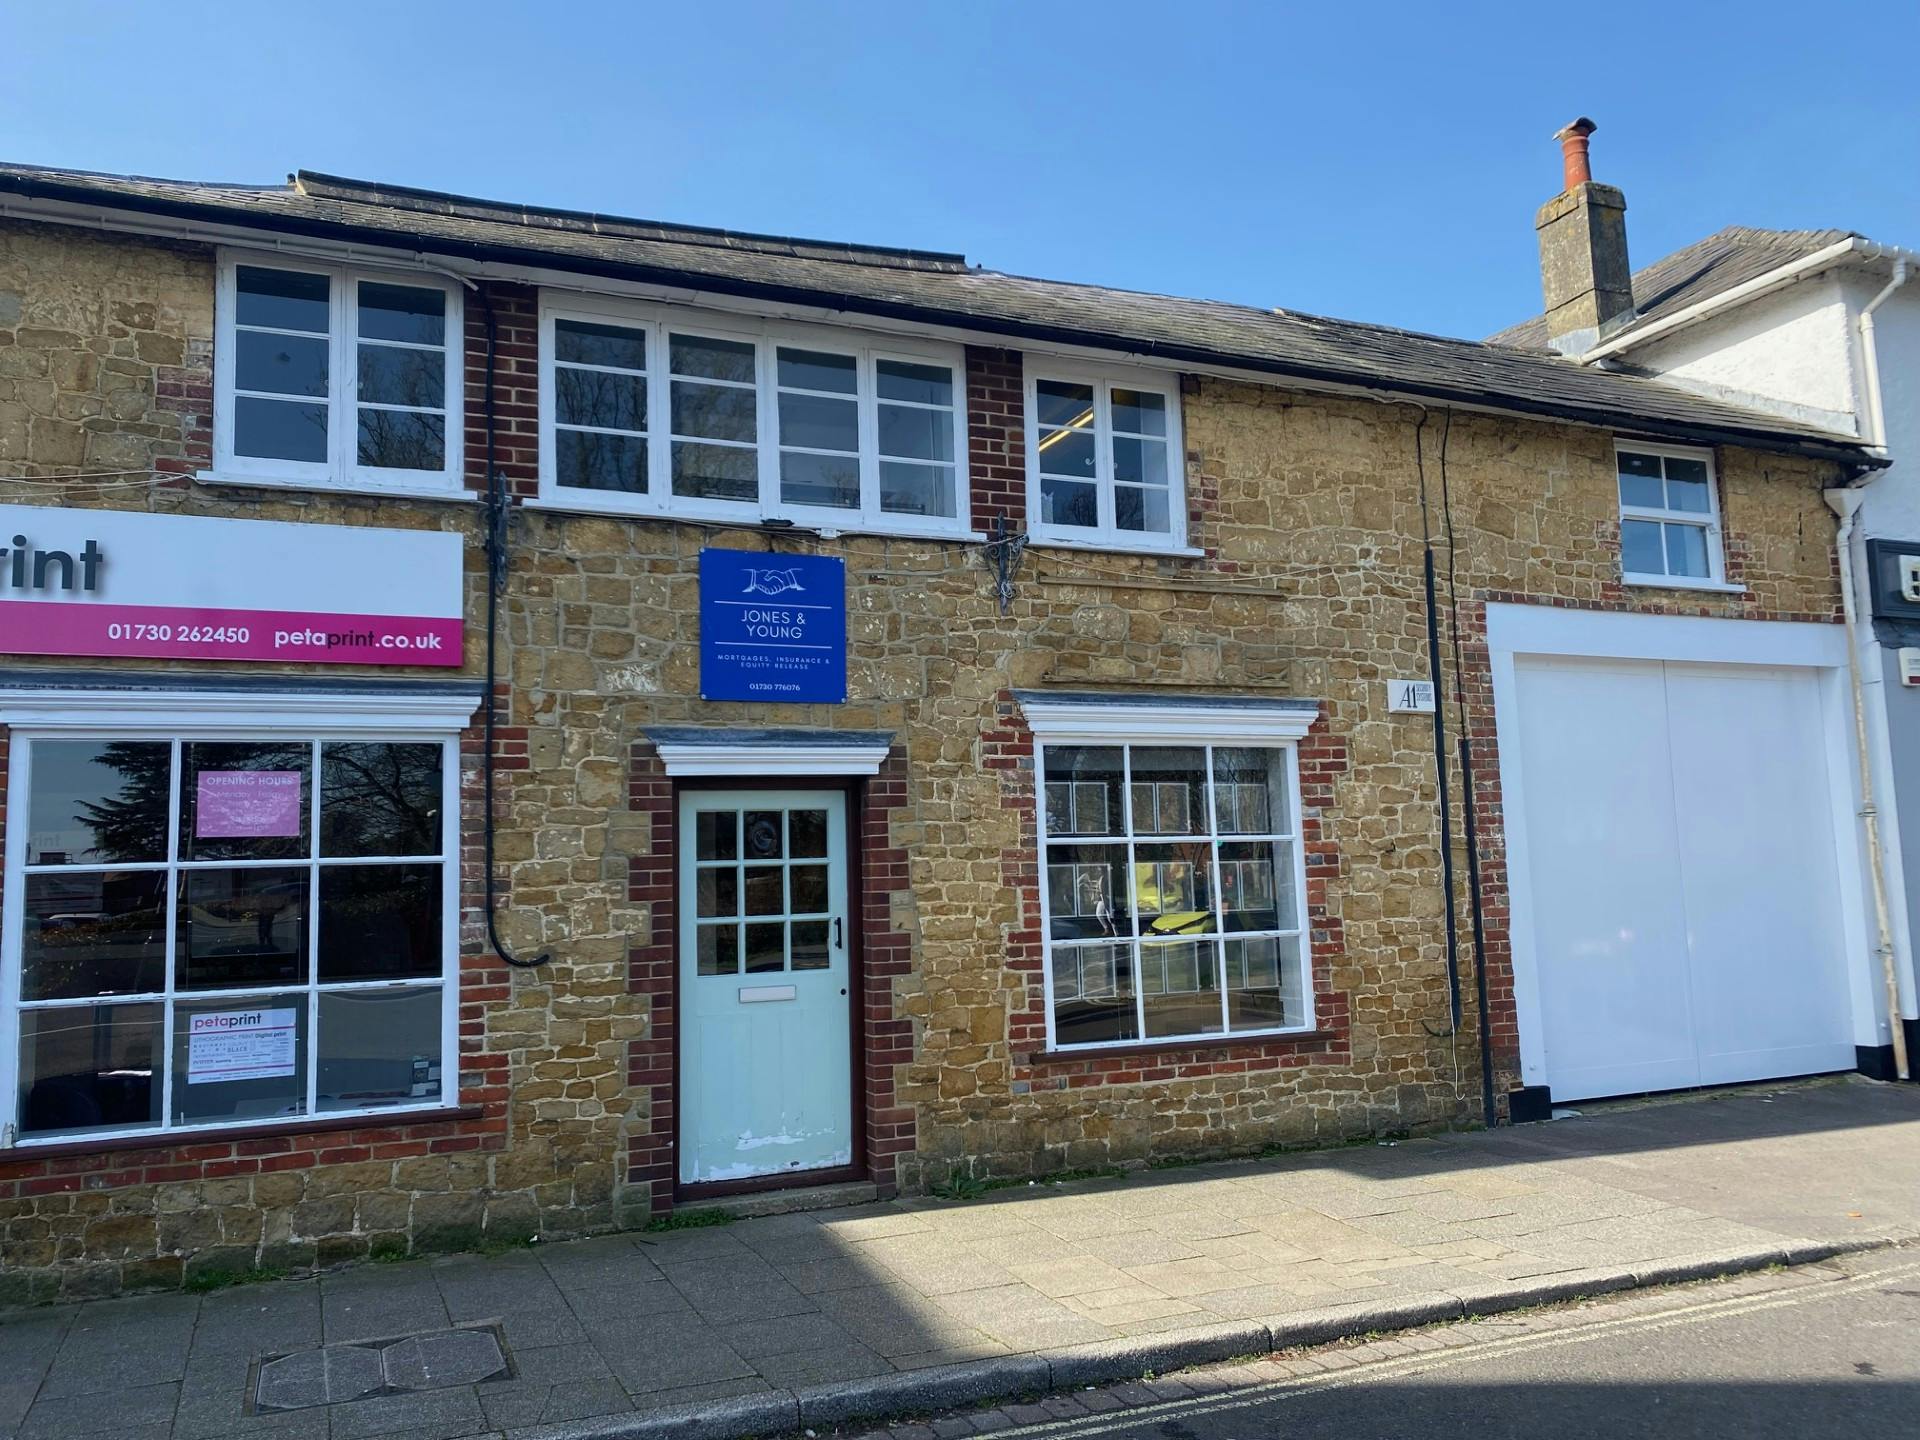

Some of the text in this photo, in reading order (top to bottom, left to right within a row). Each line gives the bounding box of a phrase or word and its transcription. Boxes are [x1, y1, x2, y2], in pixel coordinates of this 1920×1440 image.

[0, 534, 103, 591] int
[741, 610, 806, 625] JONES &
[108, 623, 442, 650] 01730 262450 petaprint.co.uk
[746, 624, 802, 639] YOUNG
[740, 661, 770, 669] EQUITY
[776, 656, 821, 664] INSURANCE
[774, 683, 801, 692] 776076
[206, 776, 294, 786] OPENING HOURS
[194, 1012, 262, 1030] petaprint
